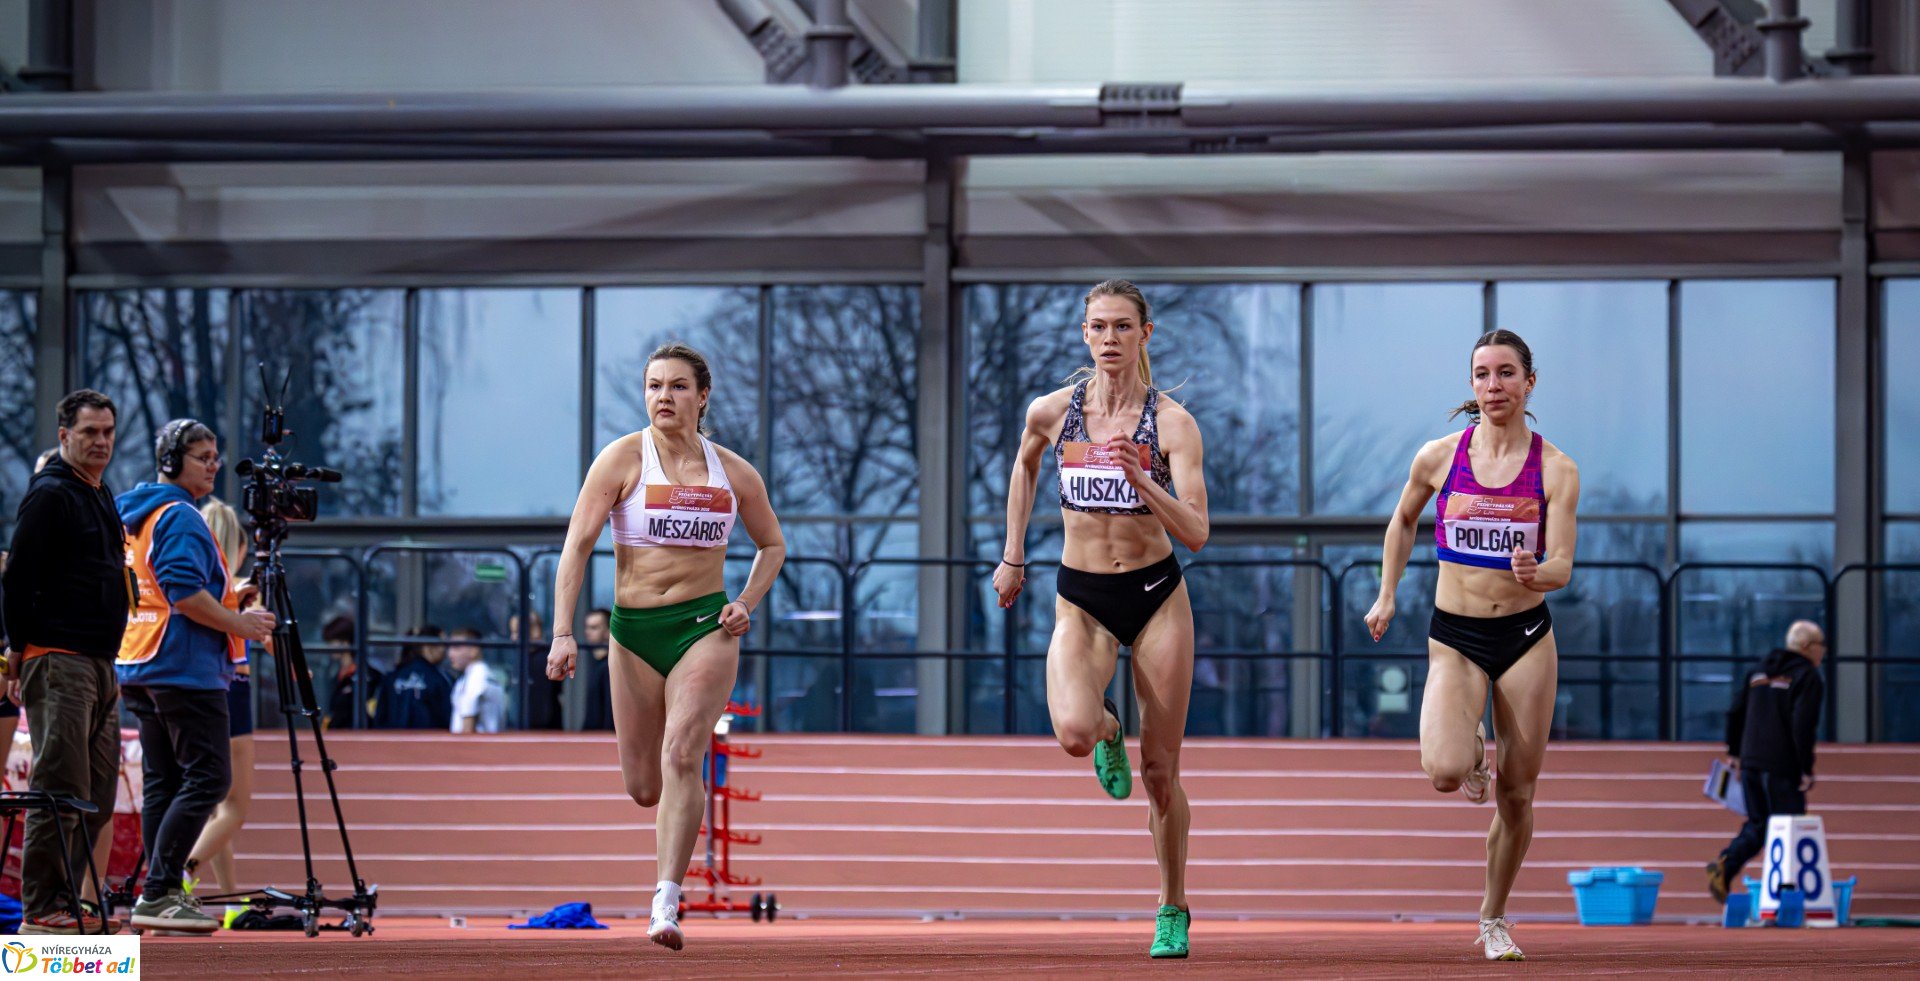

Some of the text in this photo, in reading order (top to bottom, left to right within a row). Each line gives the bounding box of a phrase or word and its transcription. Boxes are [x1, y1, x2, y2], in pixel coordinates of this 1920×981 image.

[1070, 476, 1140, 504] HUSZKA
[648, 515, 726, 541] MÉSZÁROS
[1455, 526, 1525, 553] POLGÁR
[1768, 837, 1784, 901] 8
[1796, 837, 1823, 901] 8
